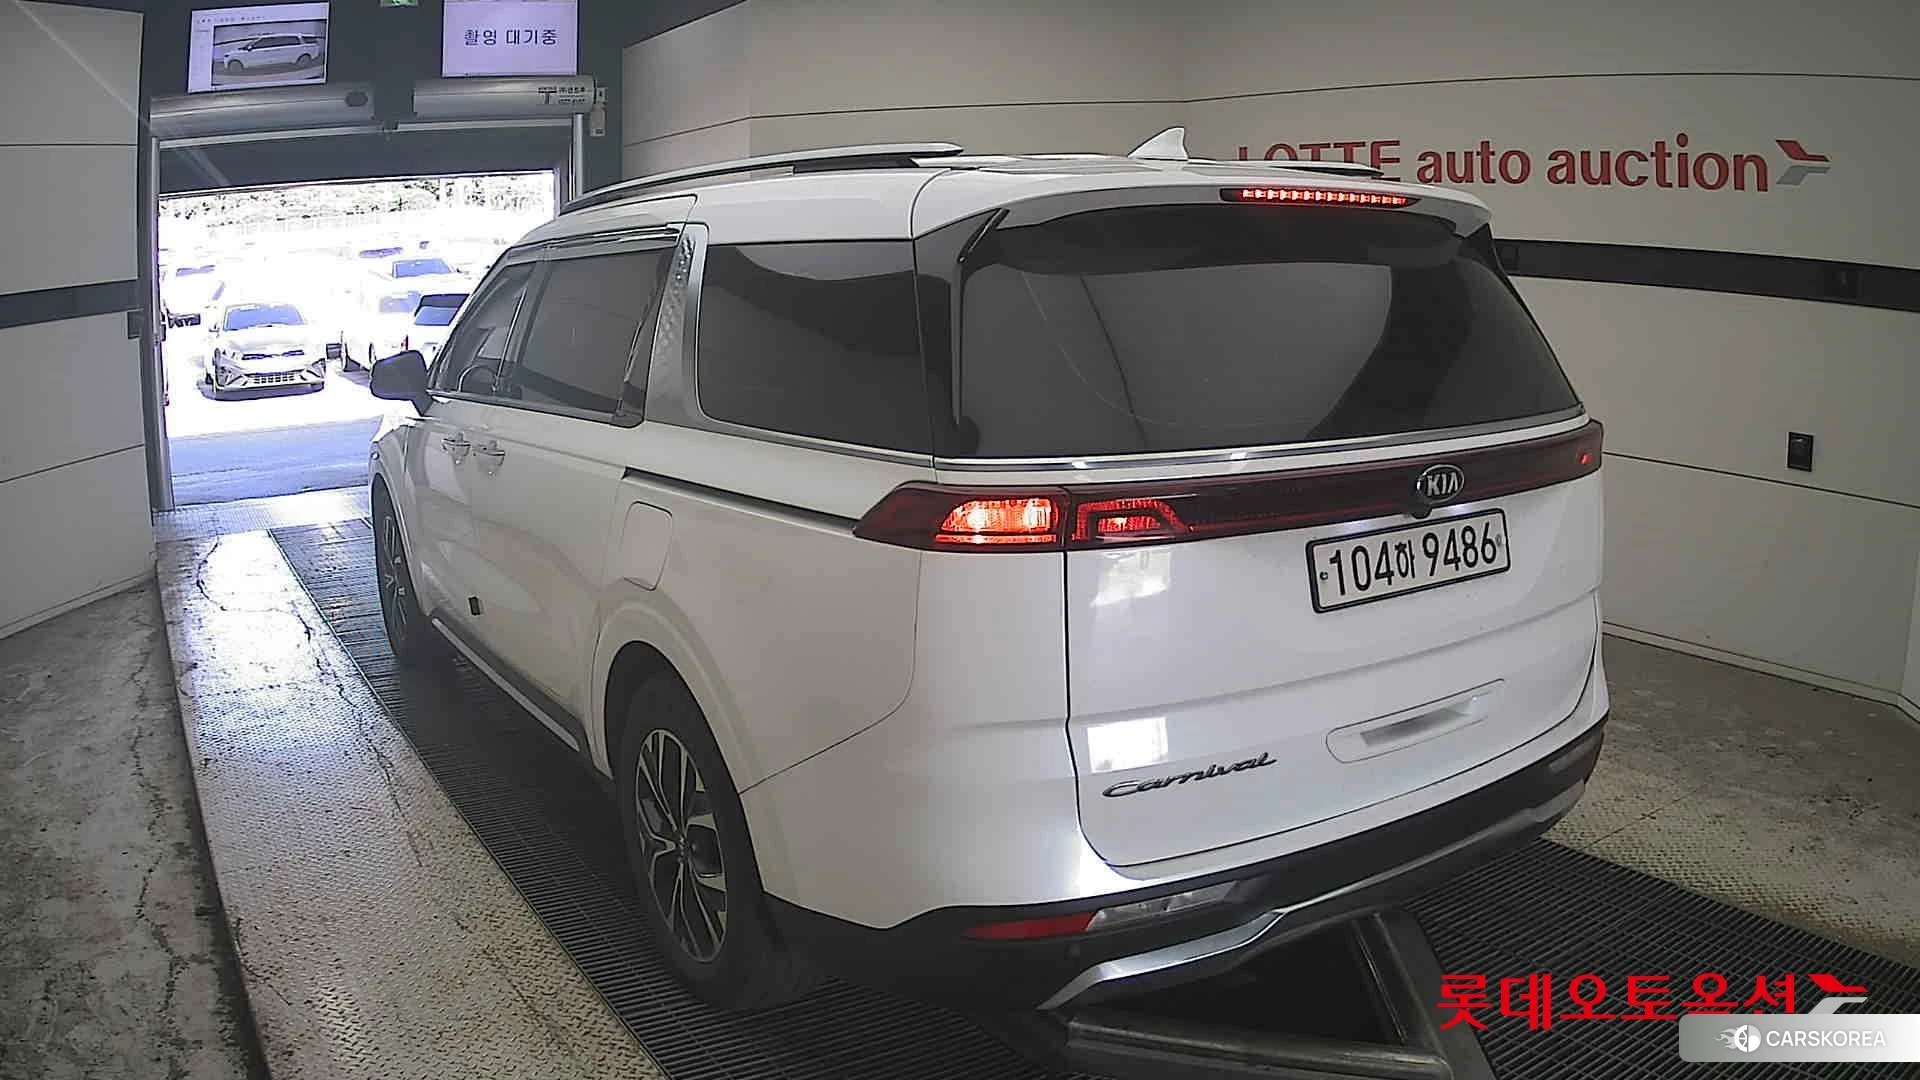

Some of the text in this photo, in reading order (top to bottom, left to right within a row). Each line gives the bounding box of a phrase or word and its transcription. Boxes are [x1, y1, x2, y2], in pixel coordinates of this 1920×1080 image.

[505, 29, 558, 46] 대기중
[1416, 140, 1532, 185] auto
[1547, 132, 1769, 193] auction
[1426, 472, 1459, 497] KIA
[1329, 521, 1497, 596] 104하 9486
[1102, 752, 1277, 798] Carnival
